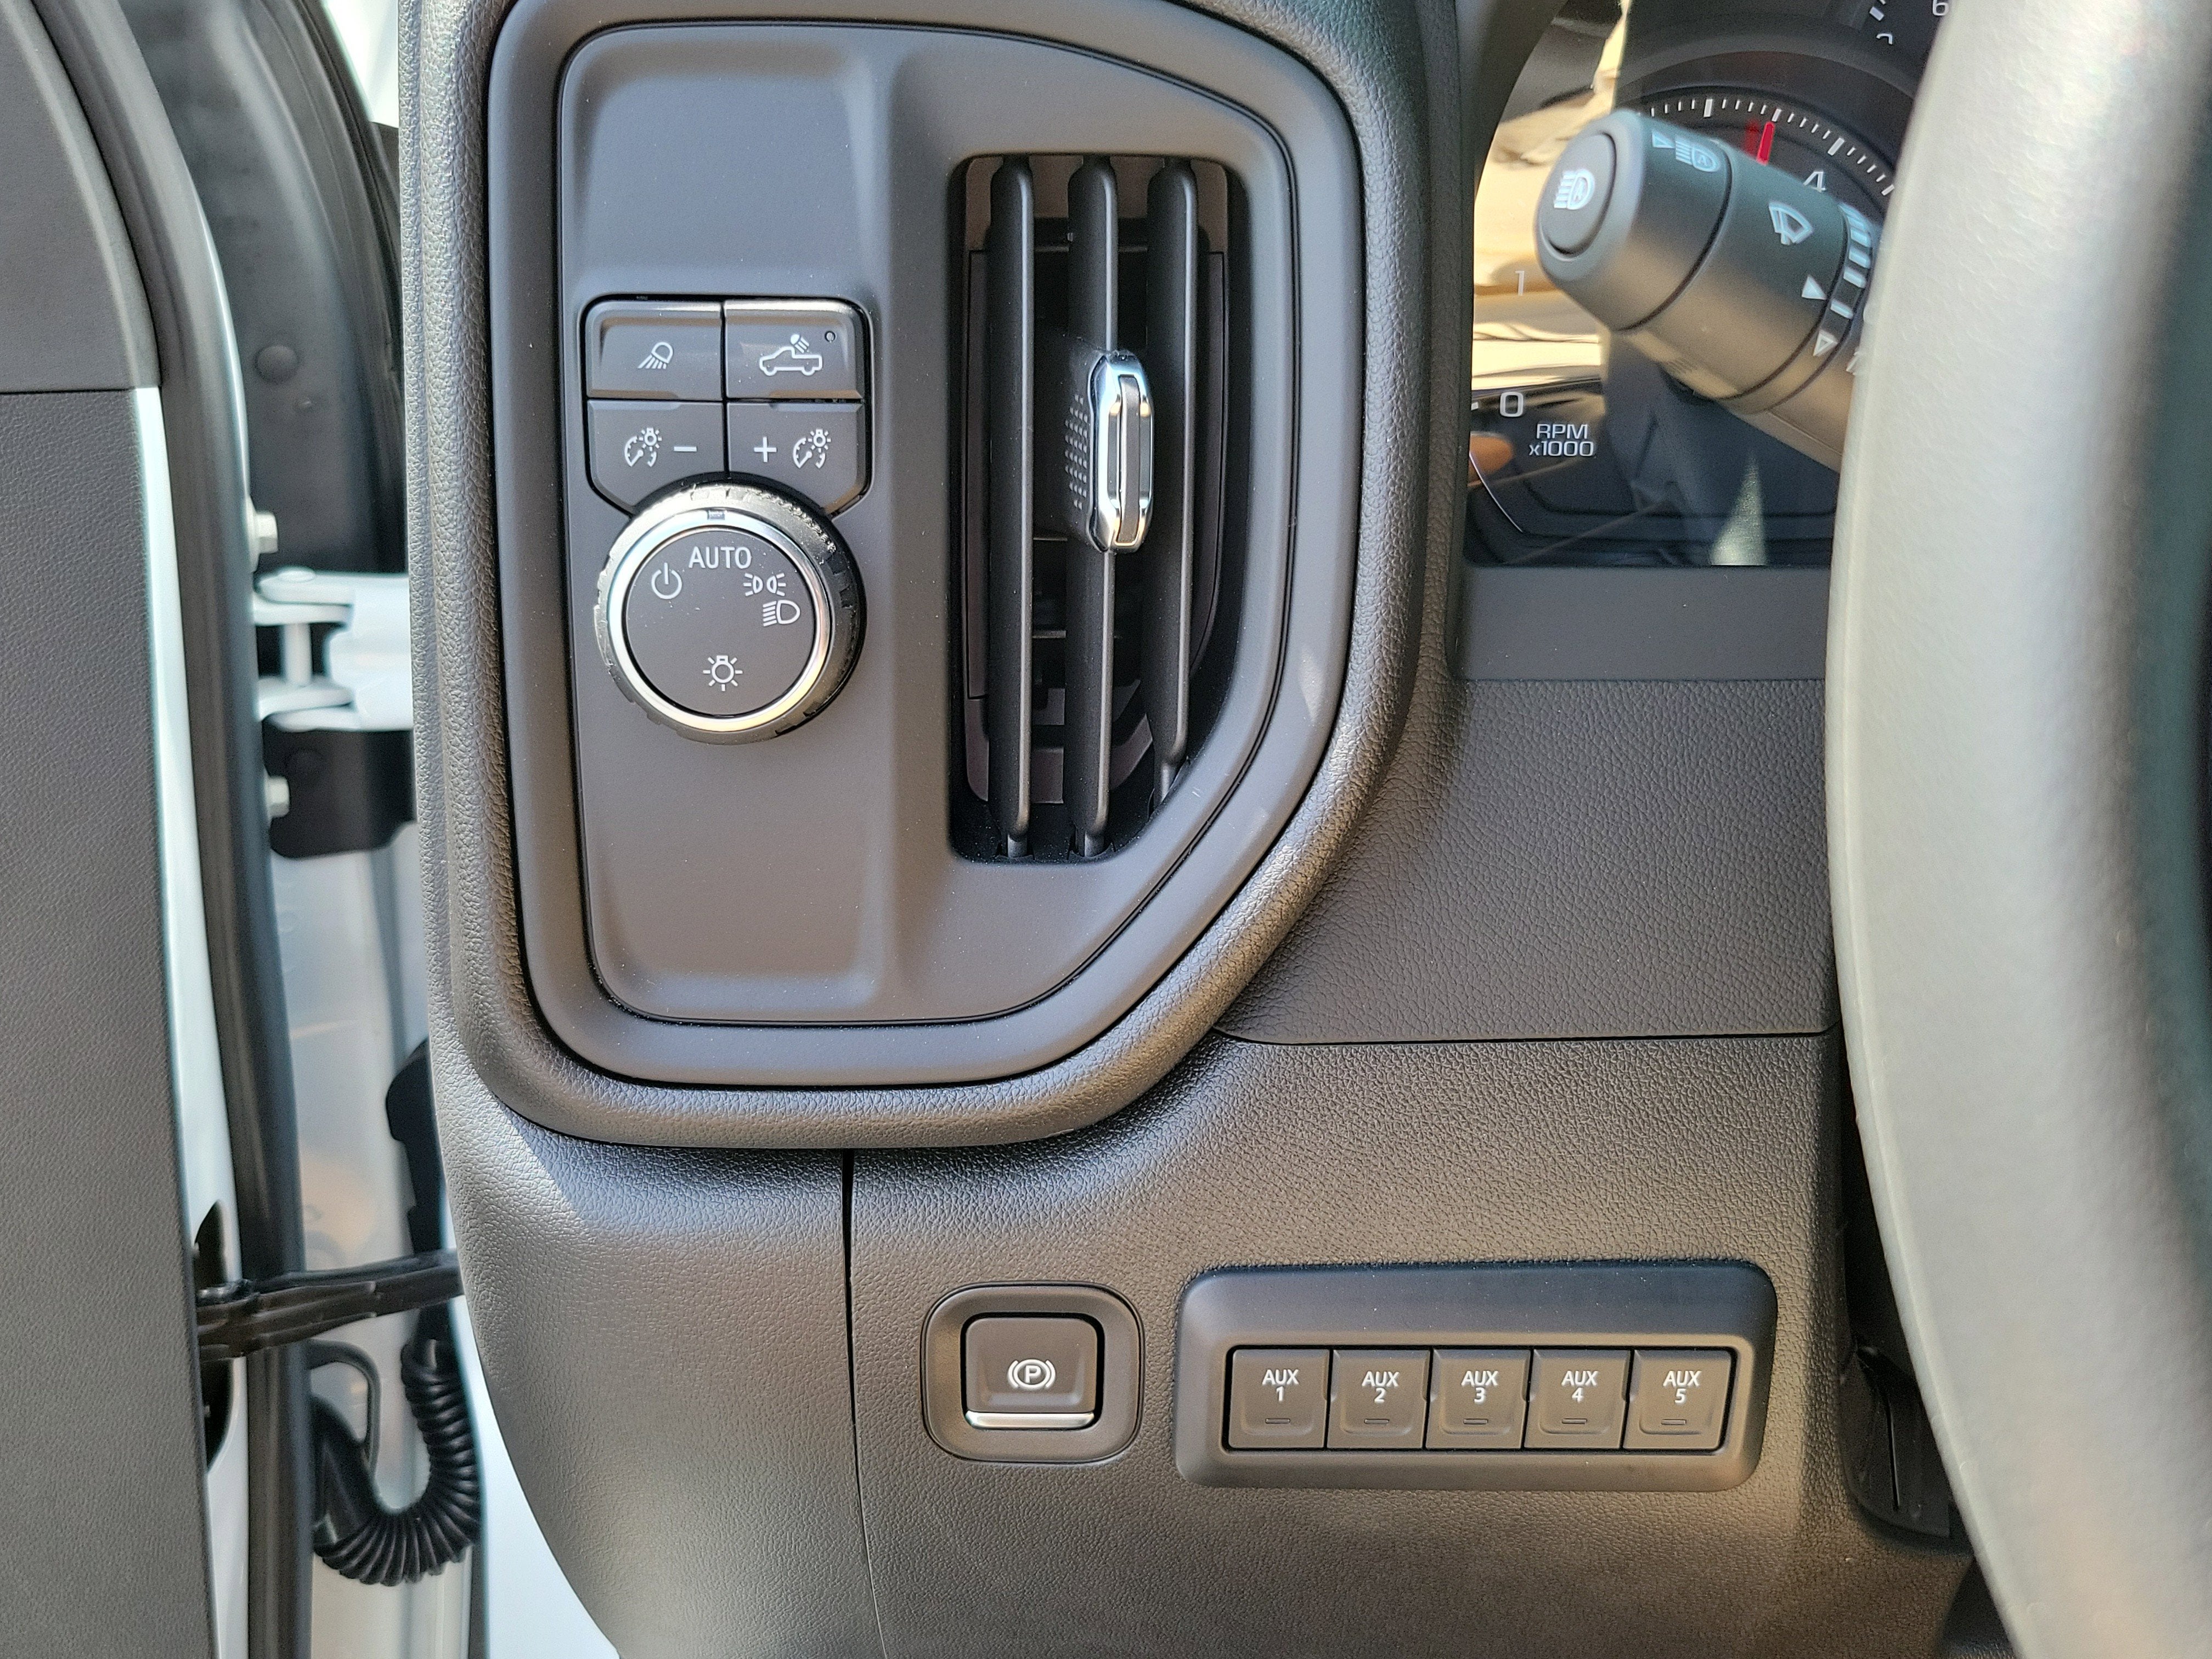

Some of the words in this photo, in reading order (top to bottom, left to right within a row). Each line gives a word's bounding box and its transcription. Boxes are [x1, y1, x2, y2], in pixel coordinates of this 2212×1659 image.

[1803, 171, 1826, 193] 4
[1515, 270, 1525, 296] 1
[1499, 391, 1523, 417] 0
[1537, 424, 1588, 439] RPM
[1528, 441, 1594, 456] x1000
[688, 546, 752, 569] AUTO
[1025, 1364, 1041, 1383] P
[1262, 1369, 1299, 1385] AUX
[1362, 1371, 1399, 1387] AUX
[1461, 1370, 1498, 1386] AUX
[1561, 1370, 1598, 1386] AUX
[1663, 1370, 1701, 1387] AUX
[1276, 1386, 1284, 1401] 1
[1374, 1387, 1386, 1403] 2
[1474, 1387, 1486, 1403] 3
[1572, 1387, 1584, 1402] 4
[1674, 1388, 1686, 1403] 5
